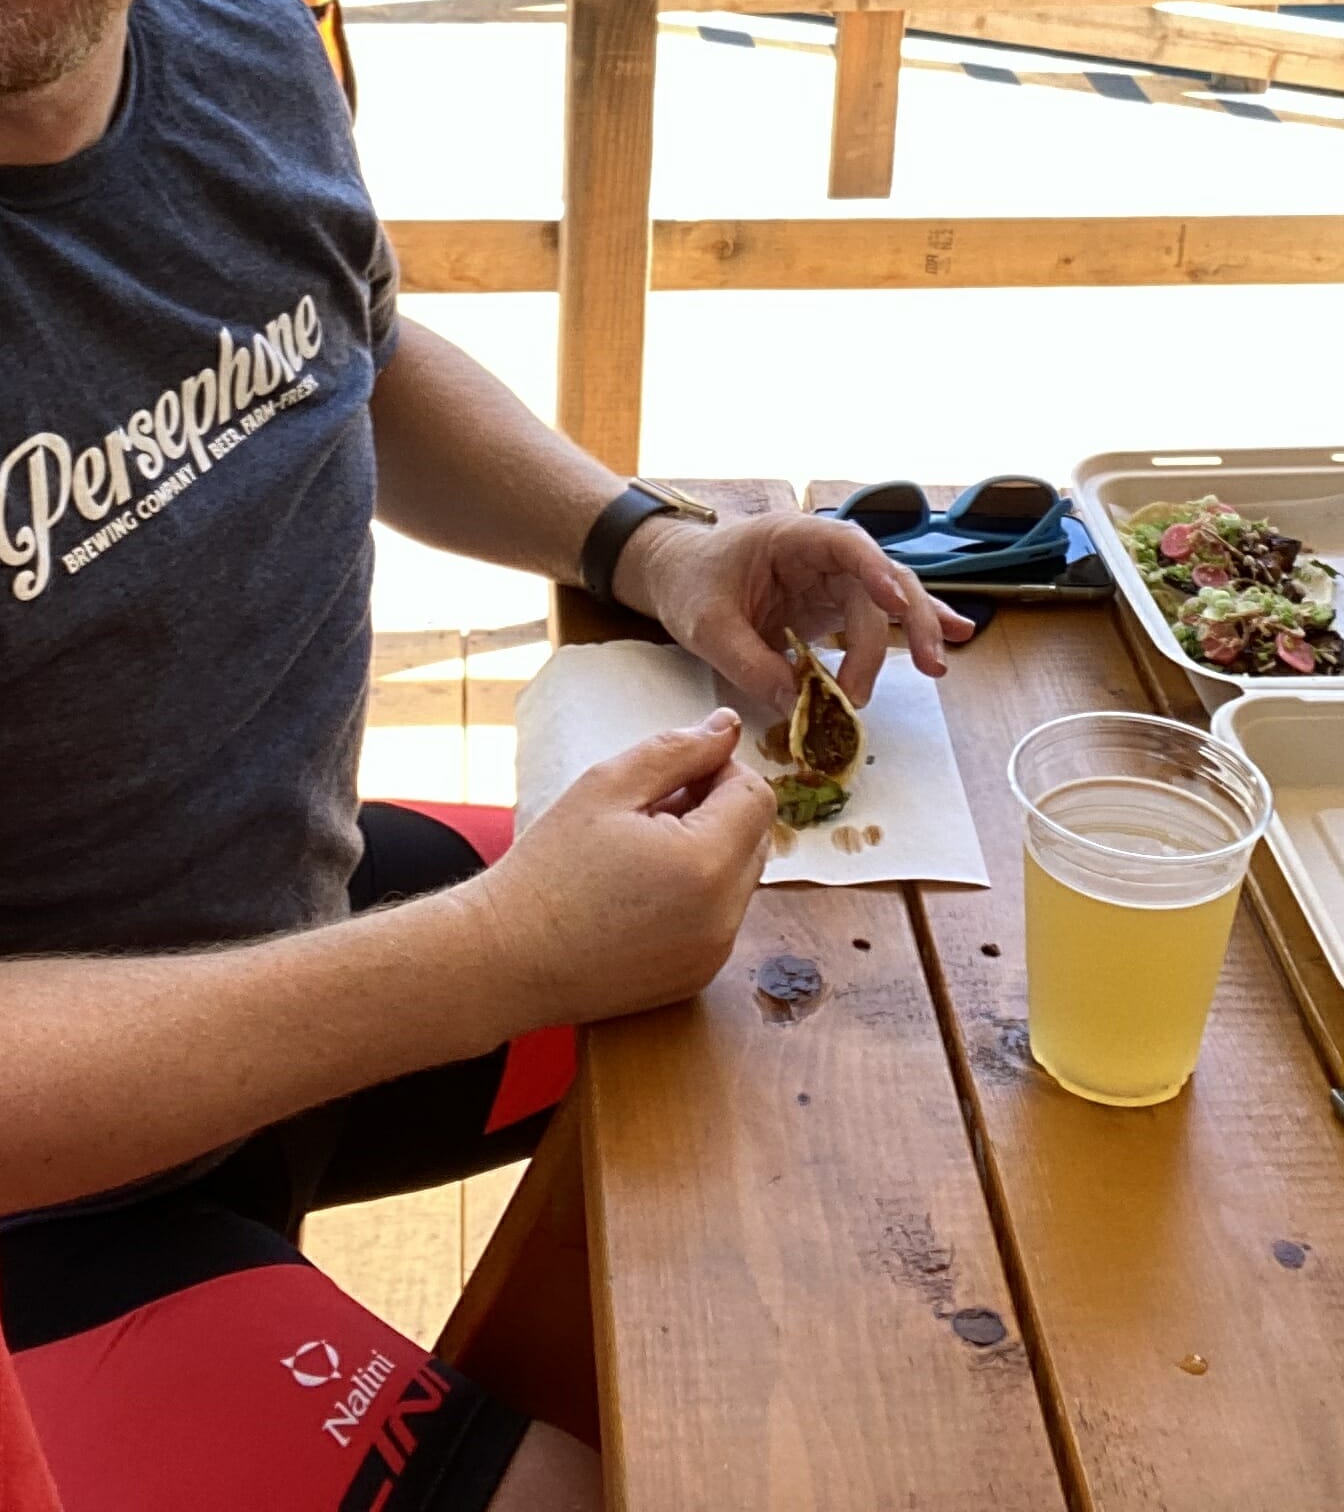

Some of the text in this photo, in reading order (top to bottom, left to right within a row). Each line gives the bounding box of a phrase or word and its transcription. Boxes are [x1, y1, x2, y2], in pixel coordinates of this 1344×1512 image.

[62, 510, 138, 574] BREWING
[136, 463, 199, 520] COMPANY
[322, 1348, 396, 1448] Nalini
